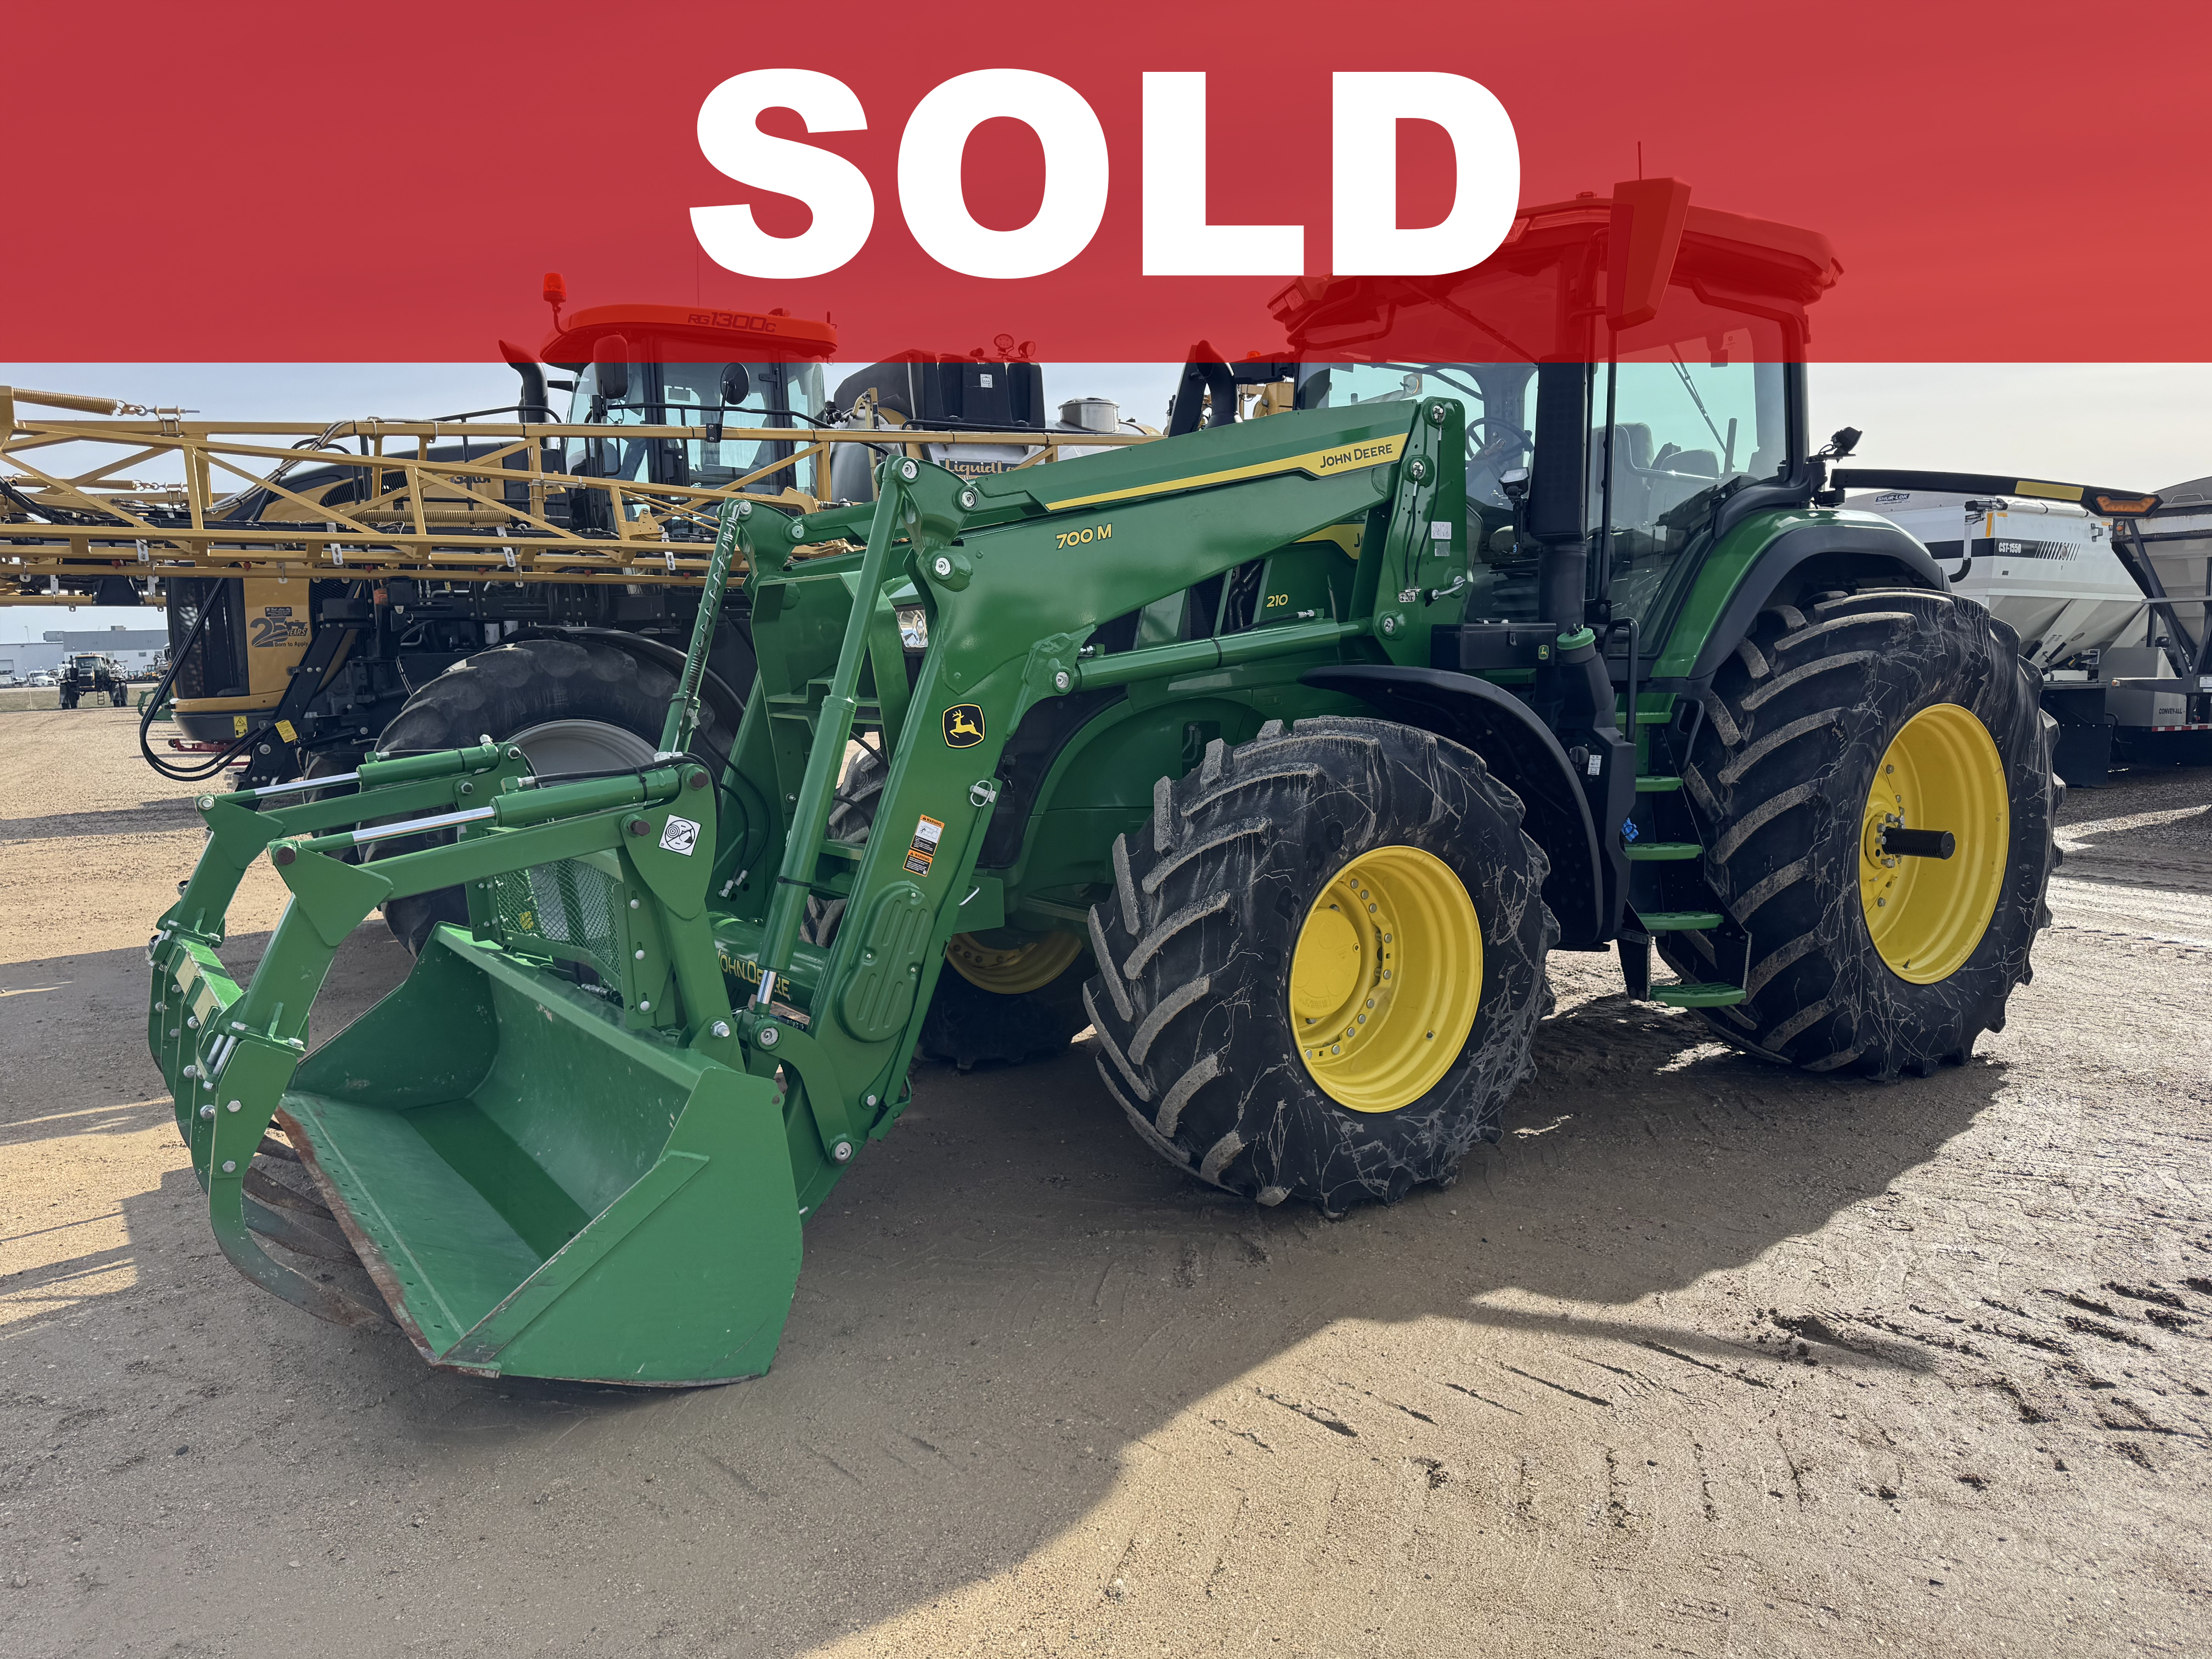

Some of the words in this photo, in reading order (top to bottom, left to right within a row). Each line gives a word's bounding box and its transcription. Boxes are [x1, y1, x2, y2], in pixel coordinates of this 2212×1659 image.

[1320, 452, 1352, 469] JOHN
[1354, 444, 1393, 461] DEERE
[1056, 527, 1094, 550] 700
[1097, 522, 1113, 541] M
[1999, 543, 2022, 554] CST-1550
[1266, 594, 1289, 608] 210
[287, 628, 307, 636] YEARS
